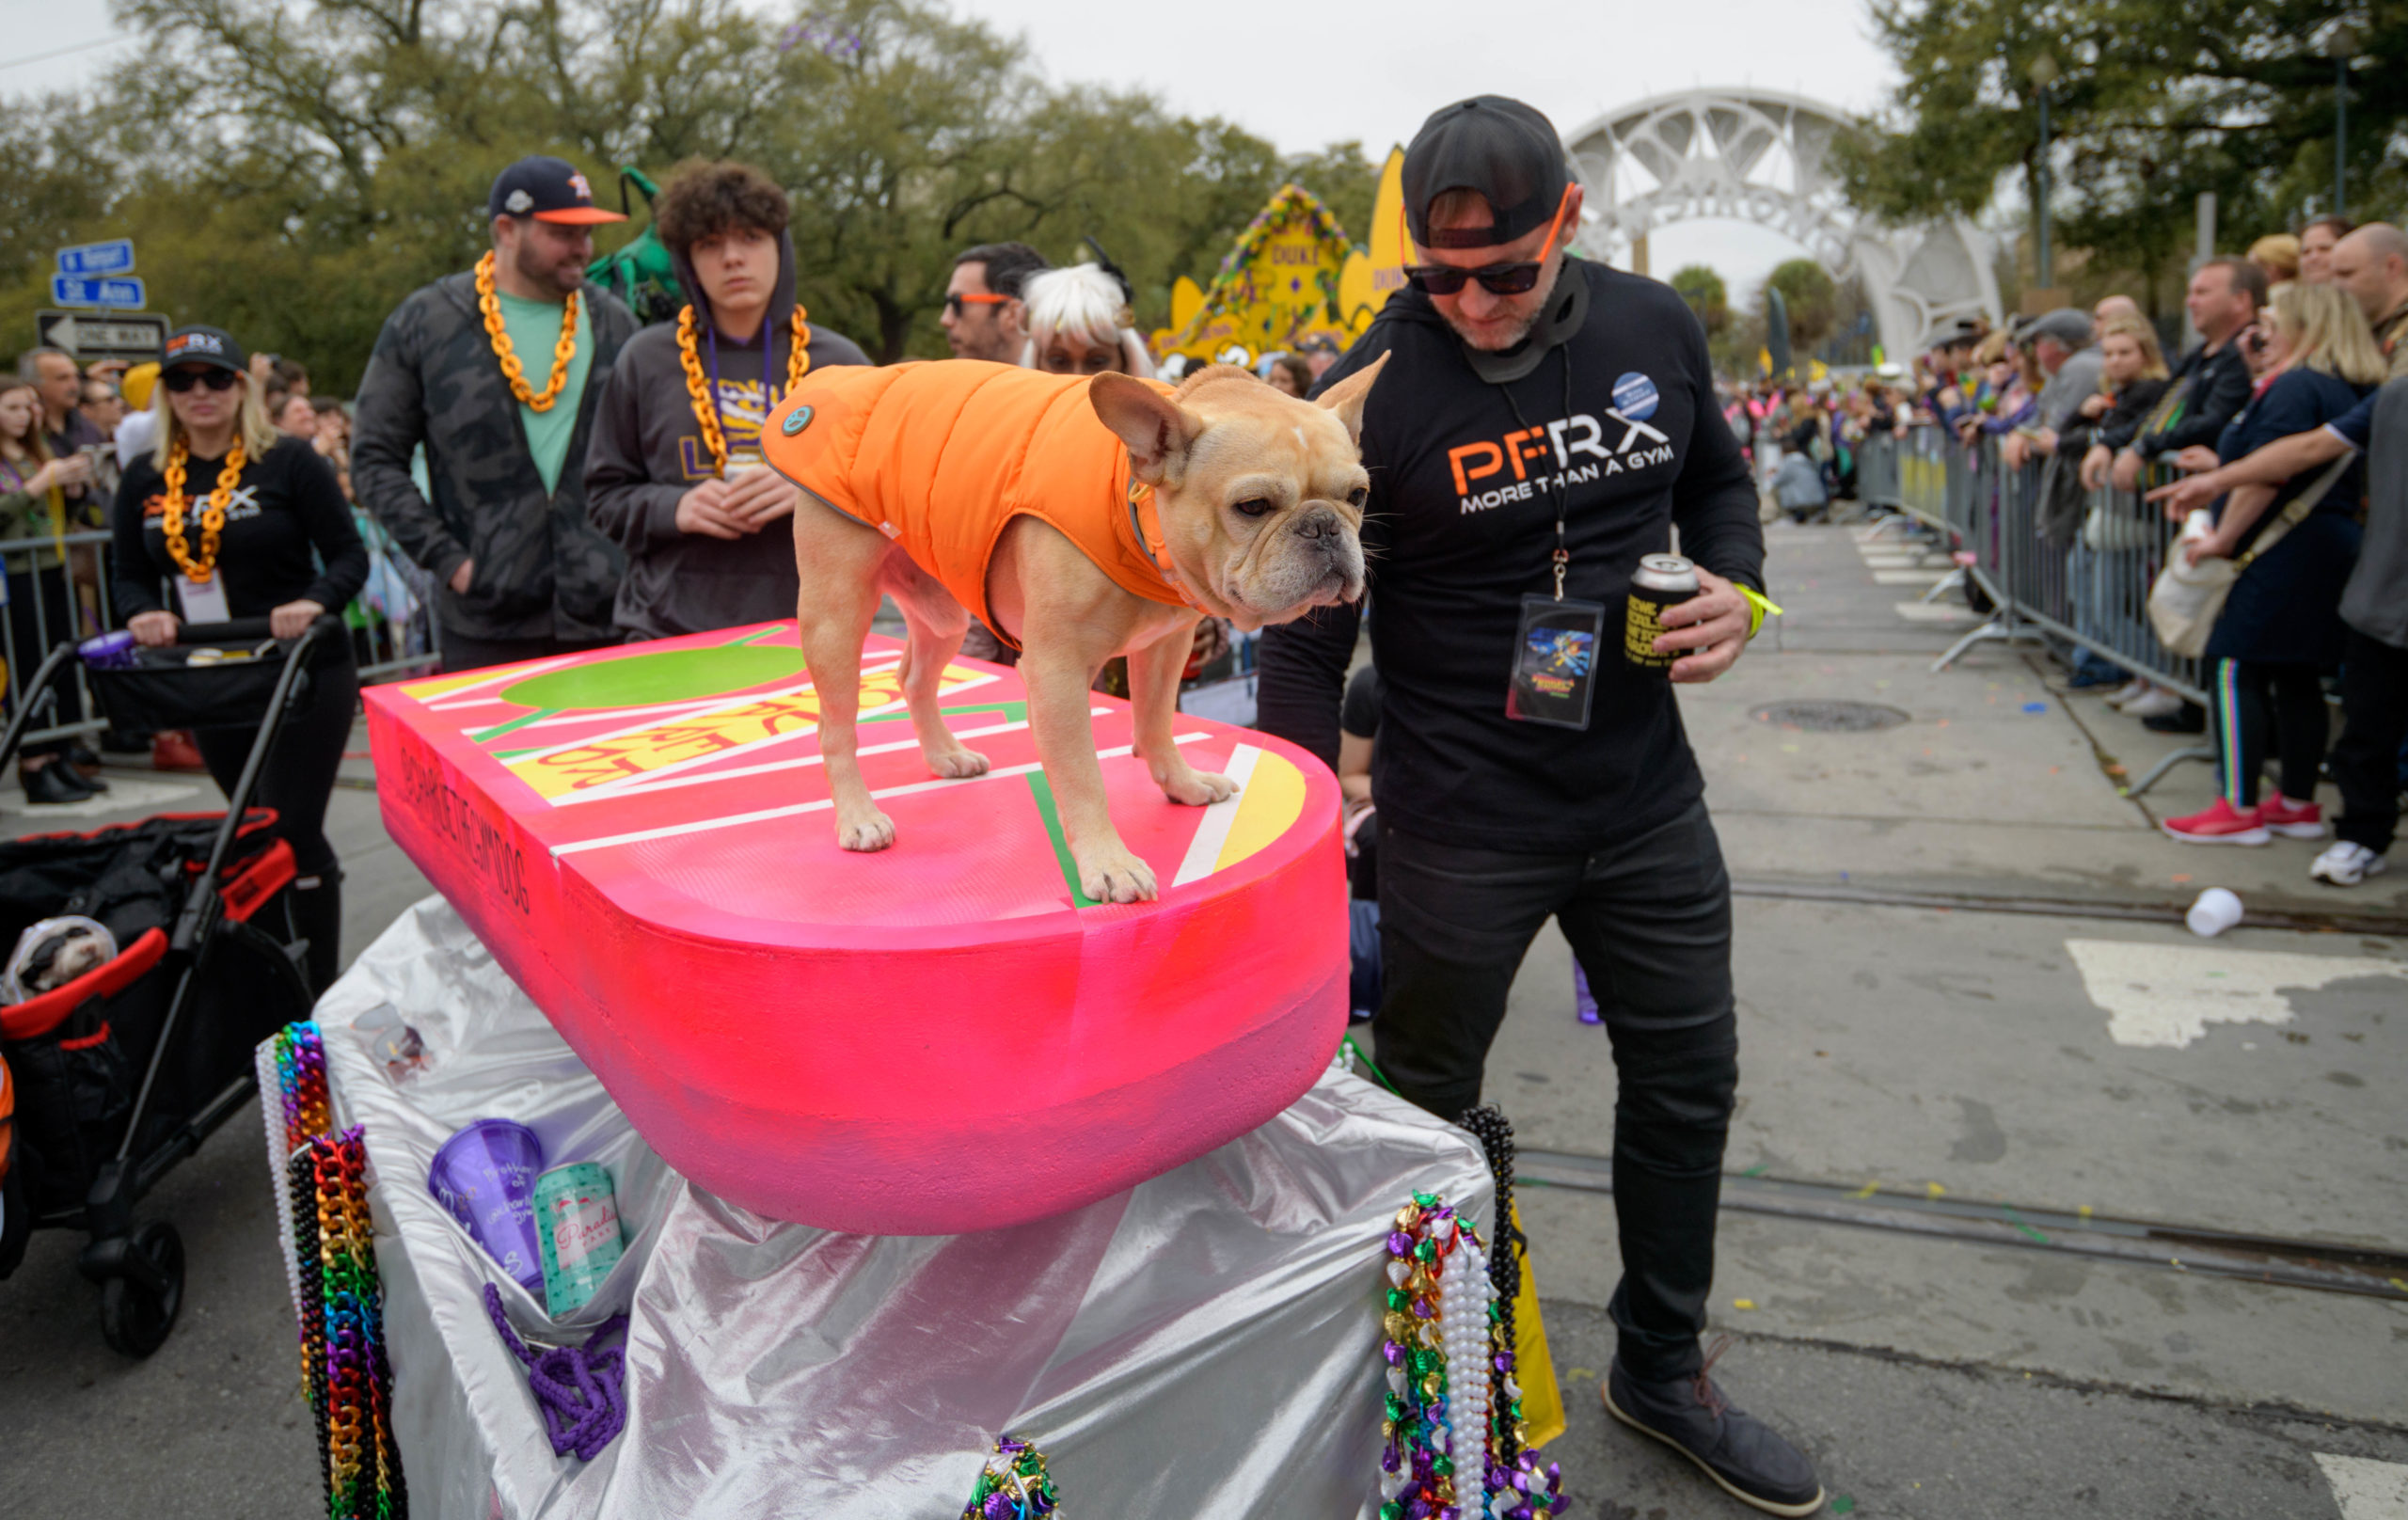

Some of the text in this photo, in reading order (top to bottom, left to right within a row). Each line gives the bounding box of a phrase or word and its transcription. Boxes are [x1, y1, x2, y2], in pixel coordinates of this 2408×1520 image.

[1447, 406, 1671, 497] PFRX
[1459, 443, 1675, 515] MORE THAN A GYM
